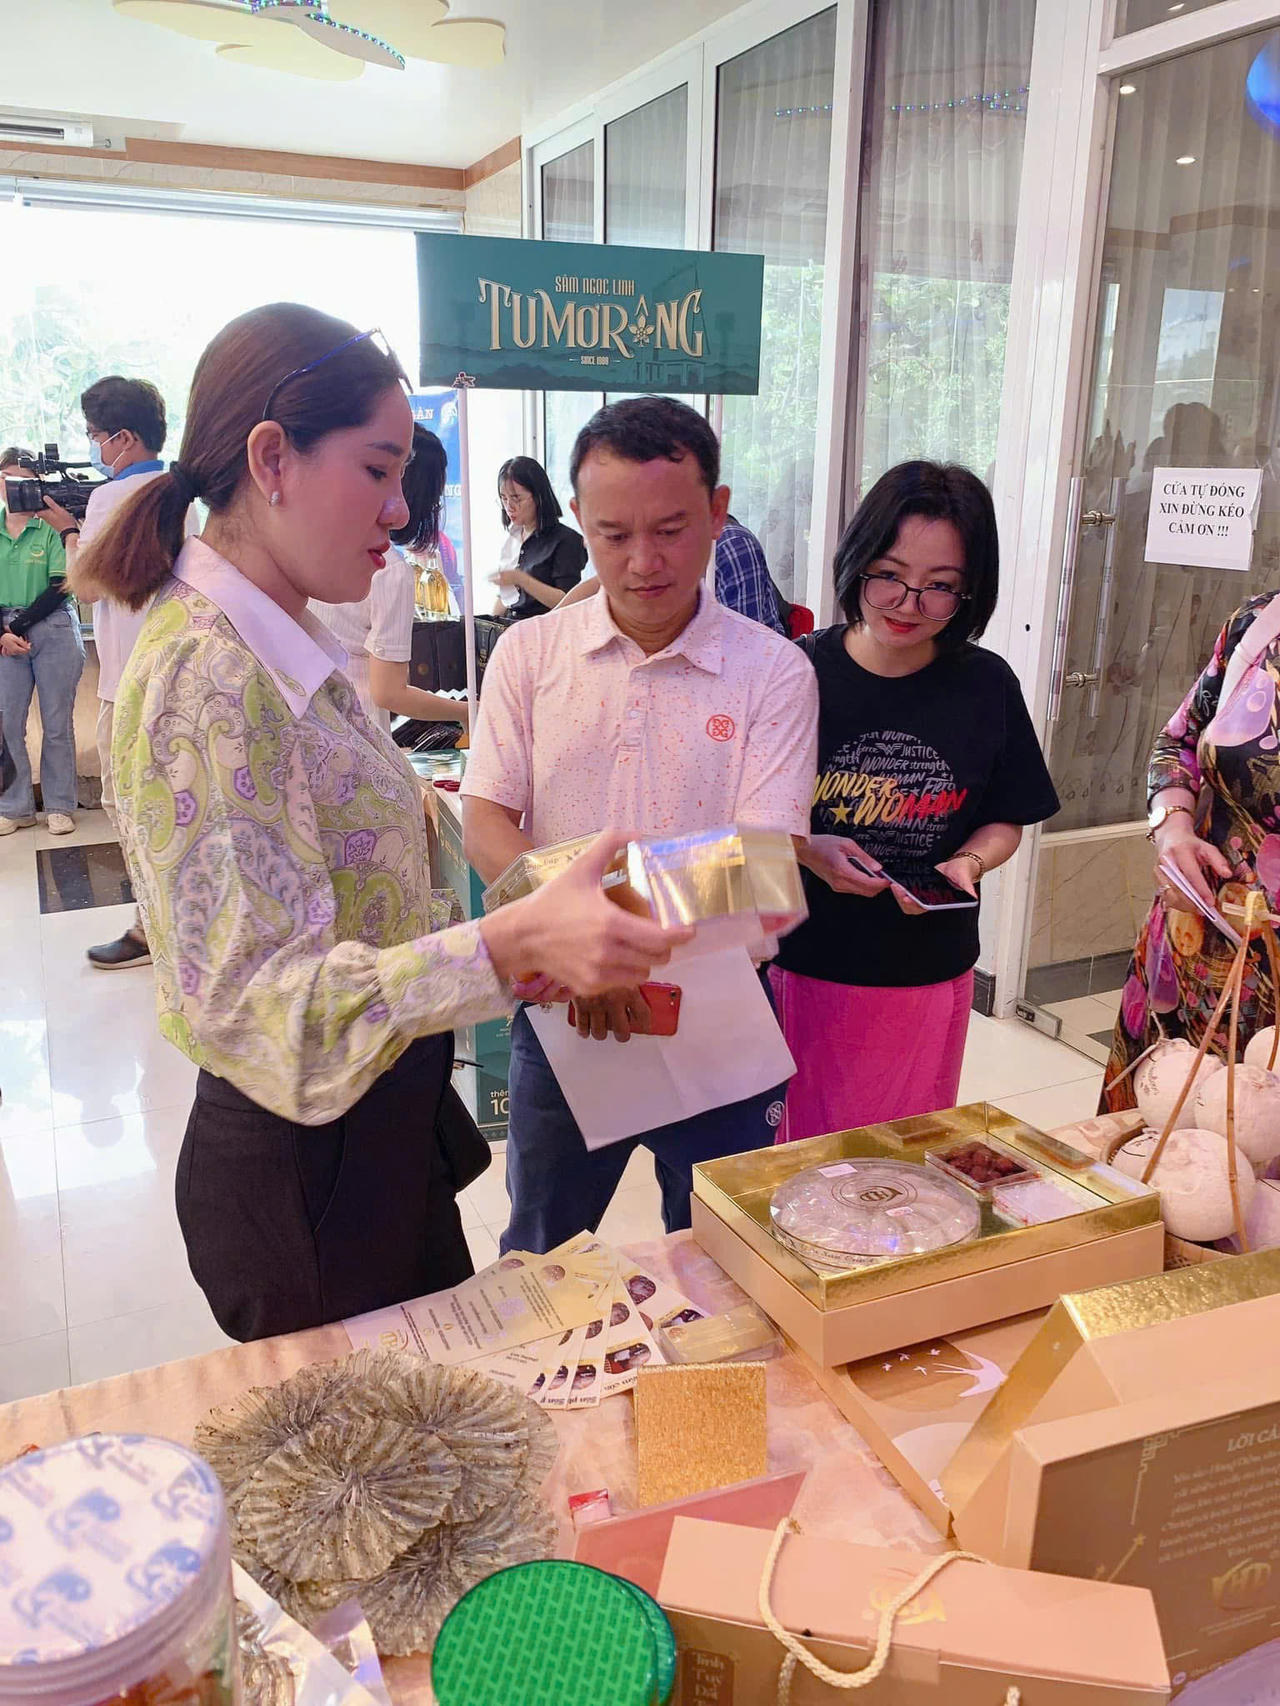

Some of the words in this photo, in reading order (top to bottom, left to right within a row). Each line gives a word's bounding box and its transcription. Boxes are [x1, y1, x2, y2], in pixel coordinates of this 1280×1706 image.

[612, 279, 635, 297] LINH
[1191, 484, 1209, 499] TỰ
[1160, 502, 1179, 514] XIN
[1182, 501, 1215, 516] ĐỪNG
[1218, 503, 1245, 518] KÉO
[1168, 520, 1194, 535] CẢM
[1197, 523, 1215, 535] ƠN
[1217, 525, 1229, 537] !!!
